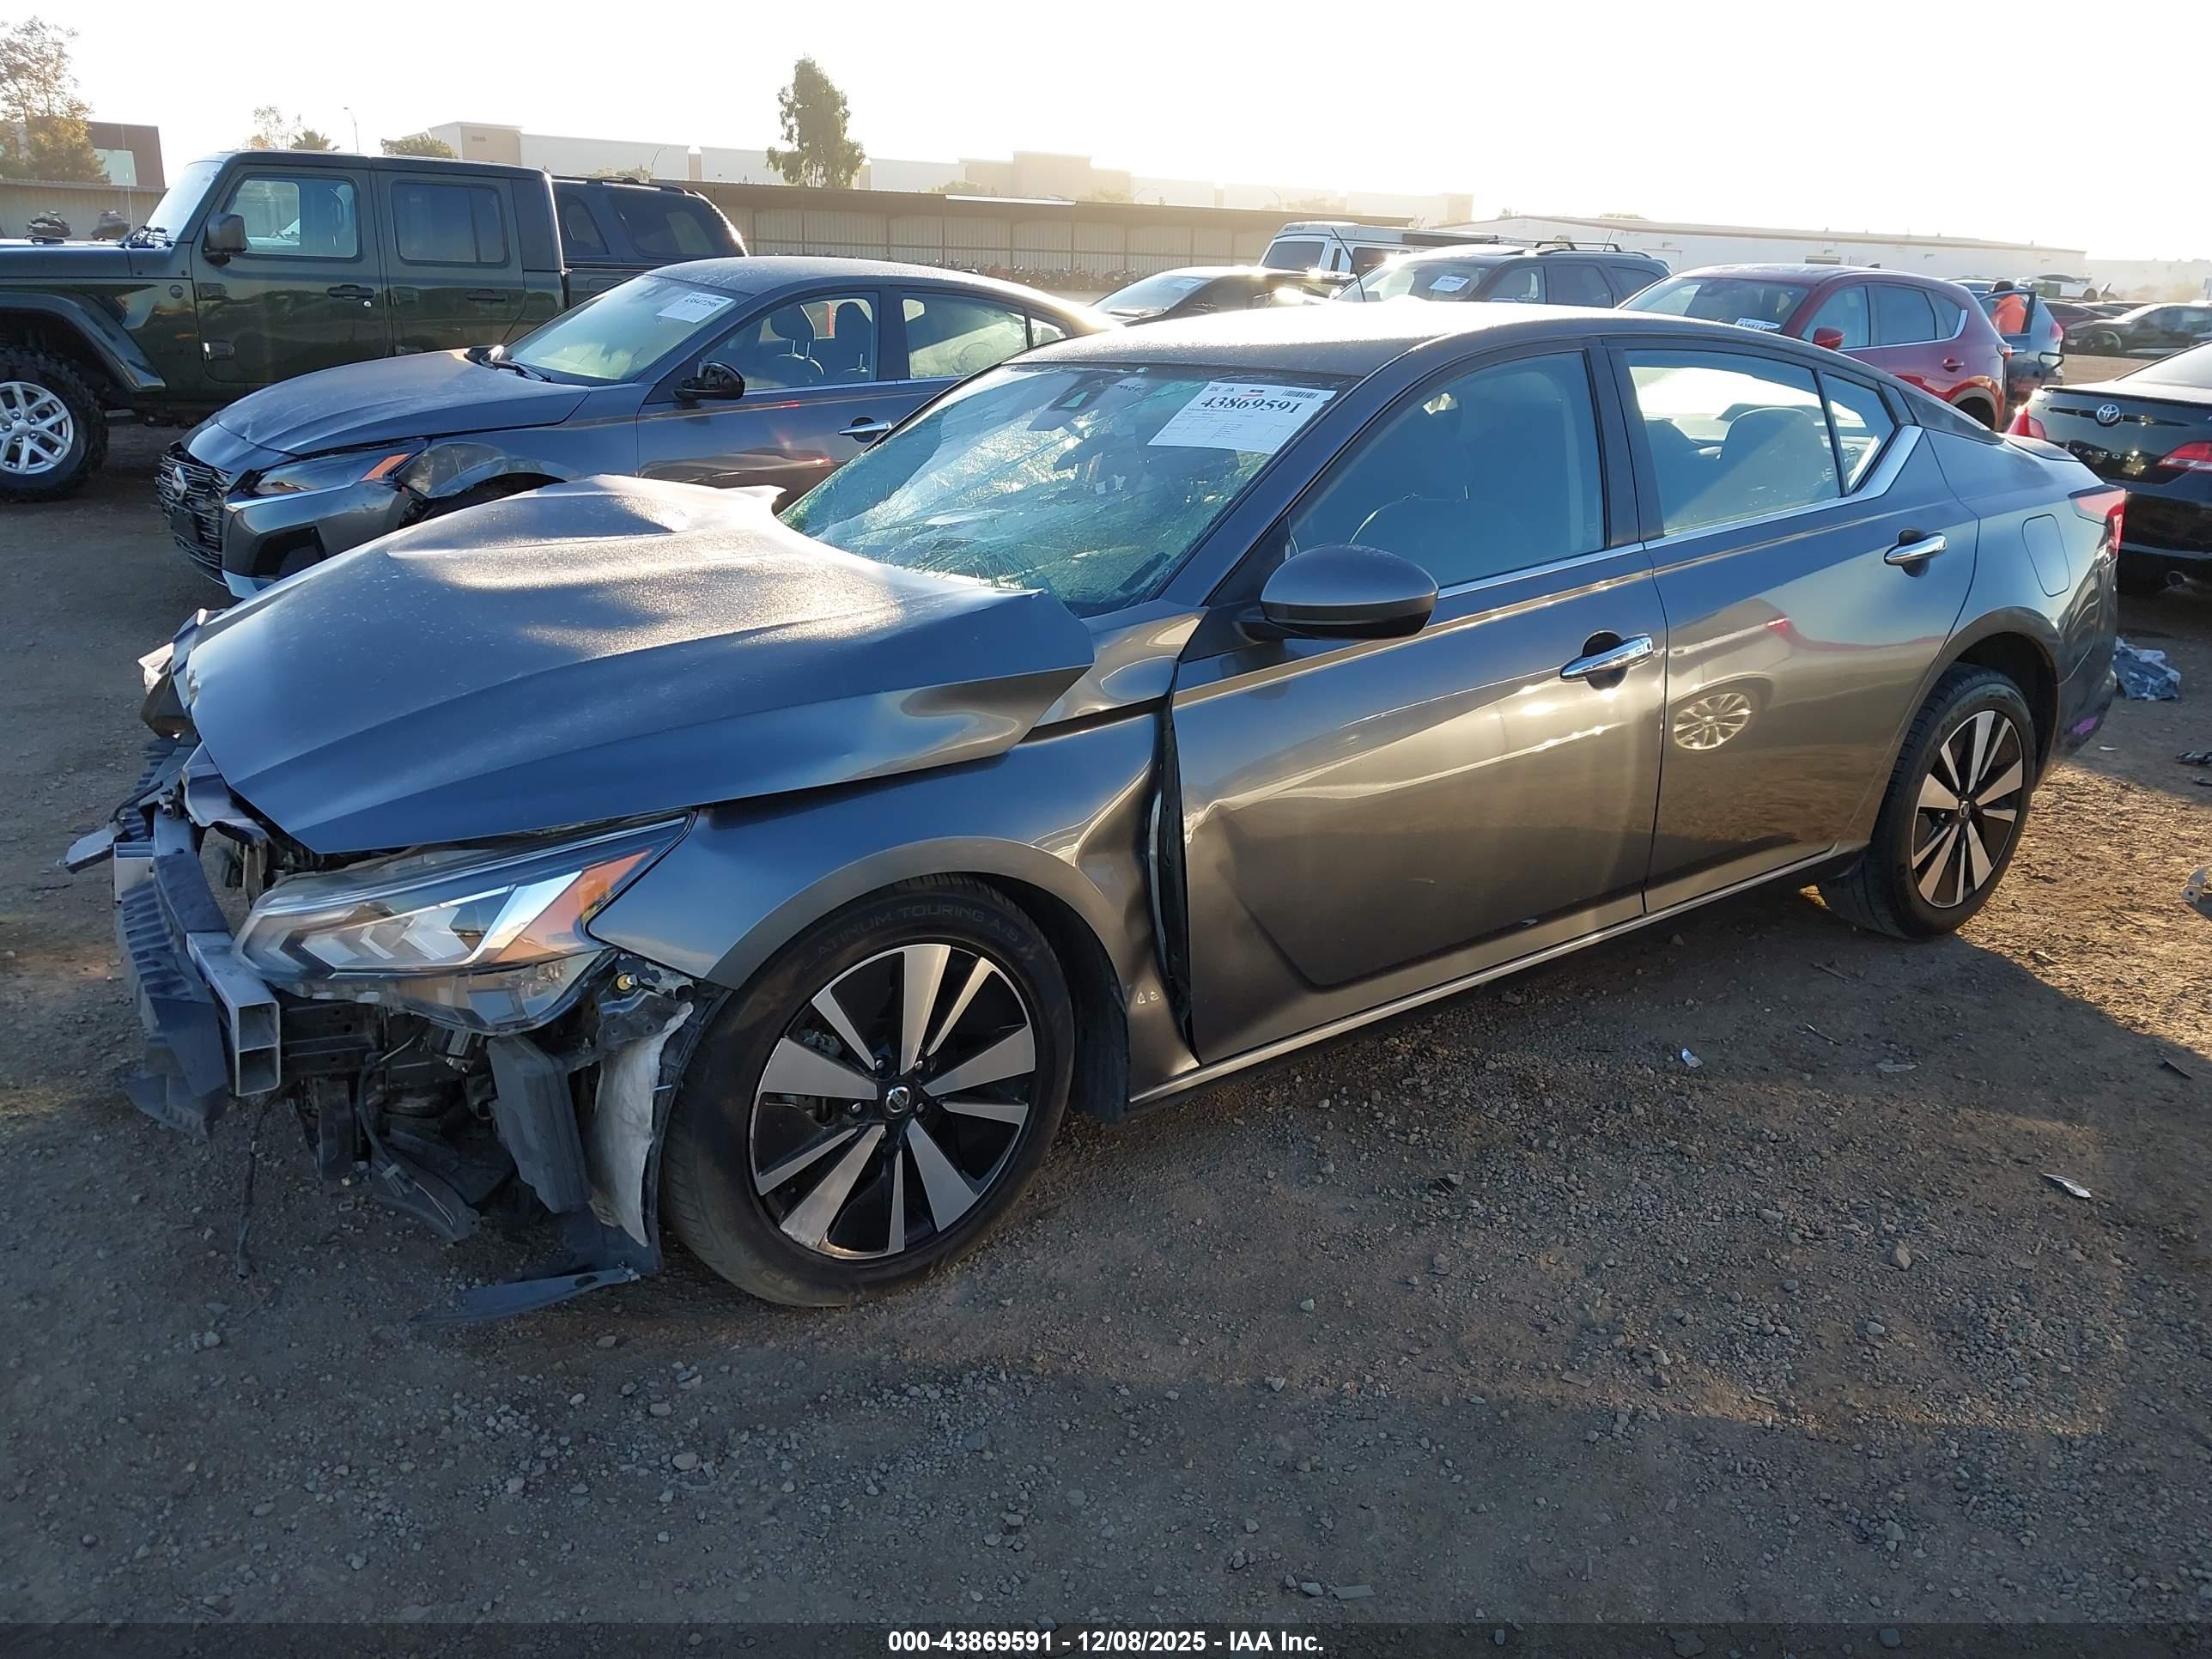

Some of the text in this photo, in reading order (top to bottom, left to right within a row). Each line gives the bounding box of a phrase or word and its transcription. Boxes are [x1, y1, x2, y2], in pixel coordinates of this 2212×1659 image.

[1201, 397, 1303, 413] 43869591
[2063, 444, 2136, 462] AVALON
[898, 904, 985, 921] TOURING
